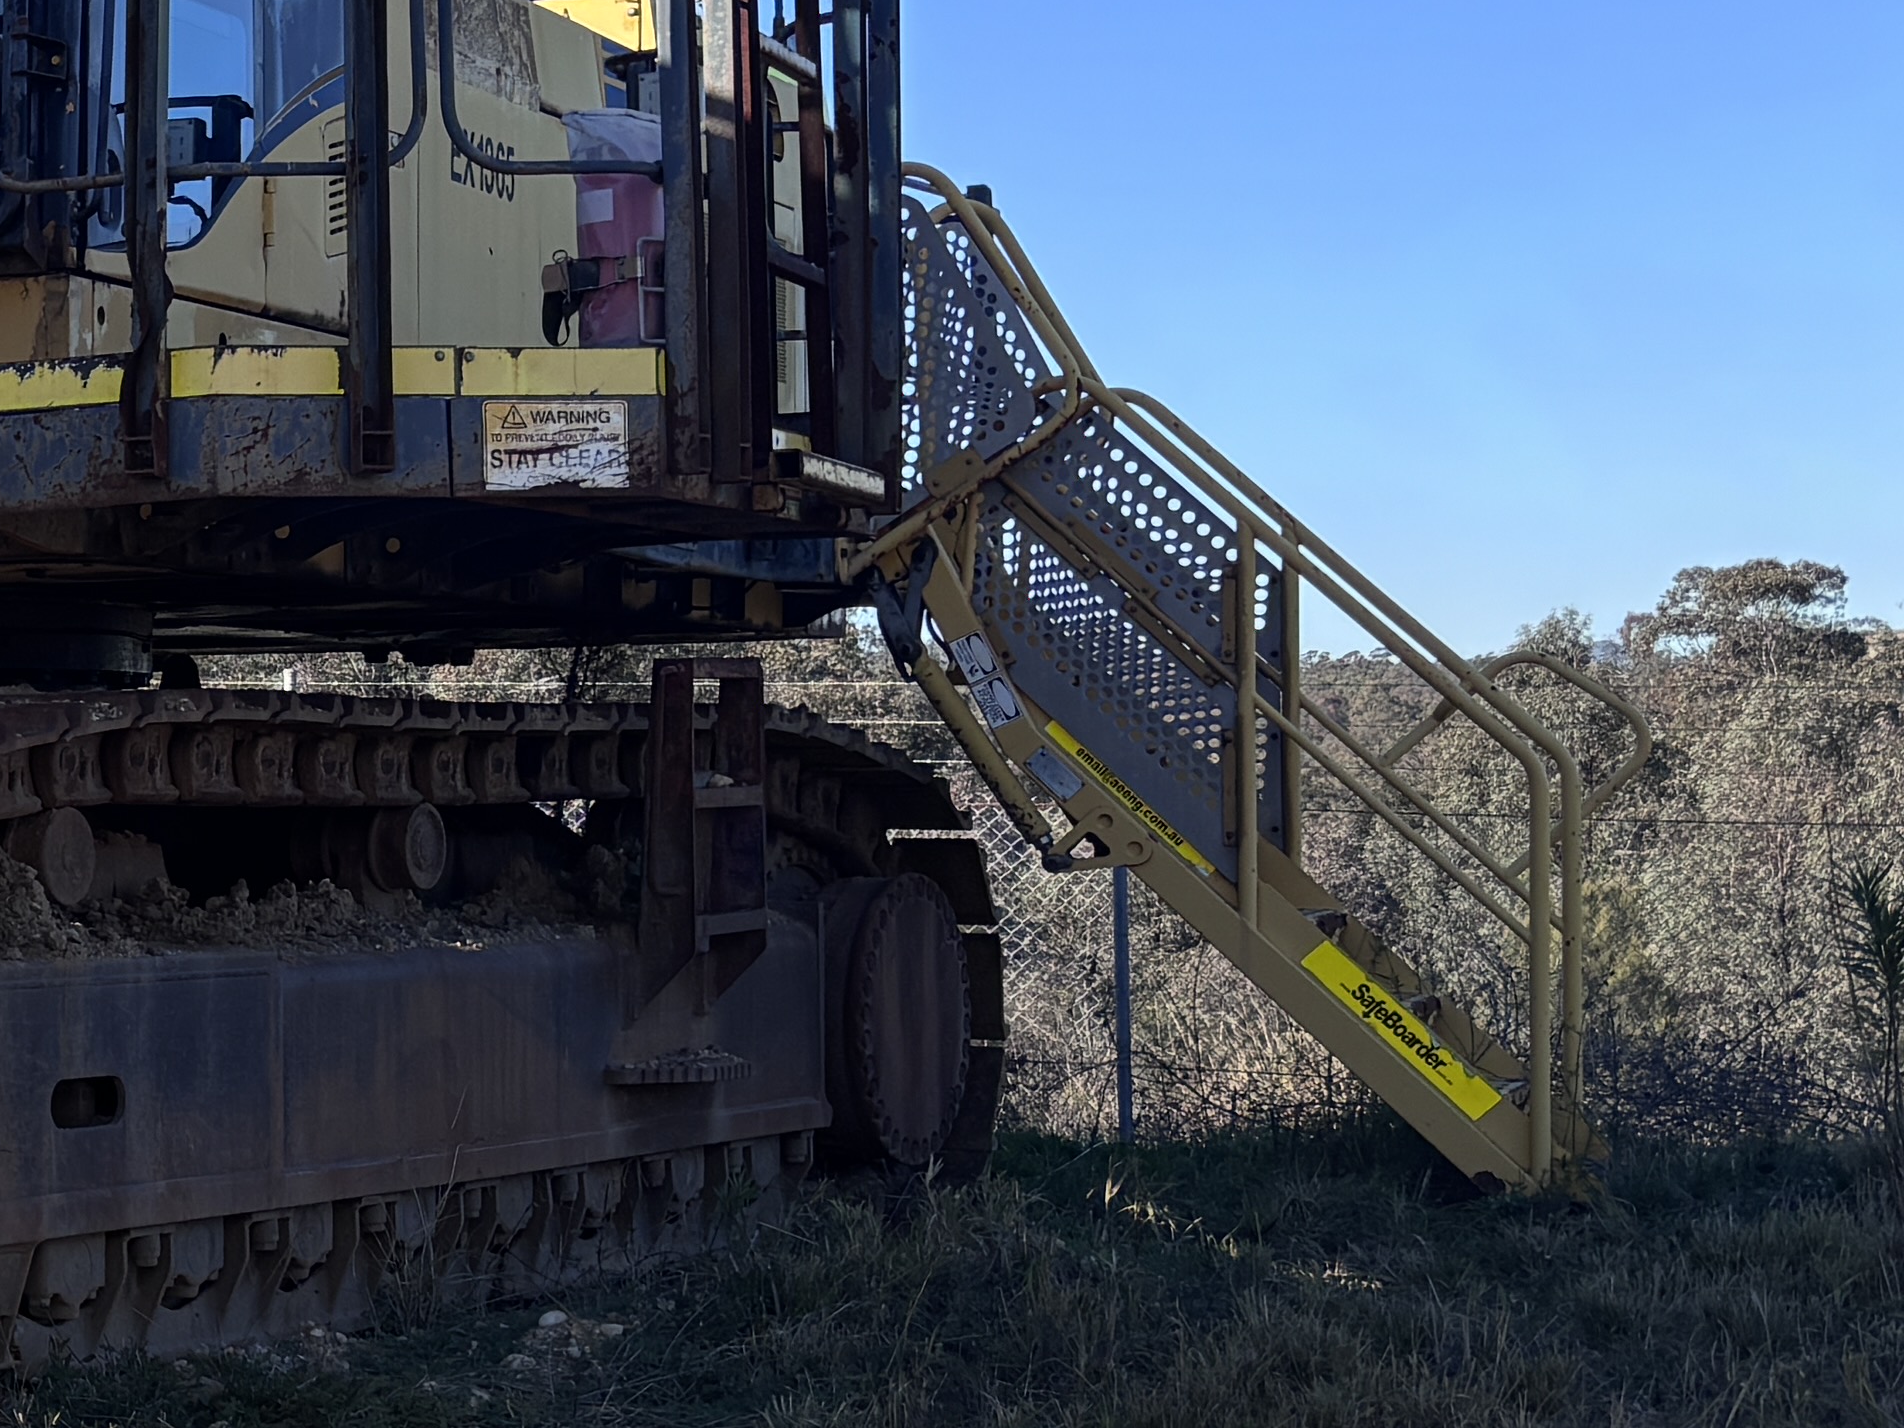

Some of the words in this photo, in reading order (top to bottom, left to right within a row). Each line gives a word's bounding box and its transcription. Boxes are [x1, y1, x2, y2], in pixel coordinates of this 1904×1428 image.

[530, 410, 611, 425] WARNING
[492, 433, 502, 443] TO
[490, 449, 541, 469] STAY
